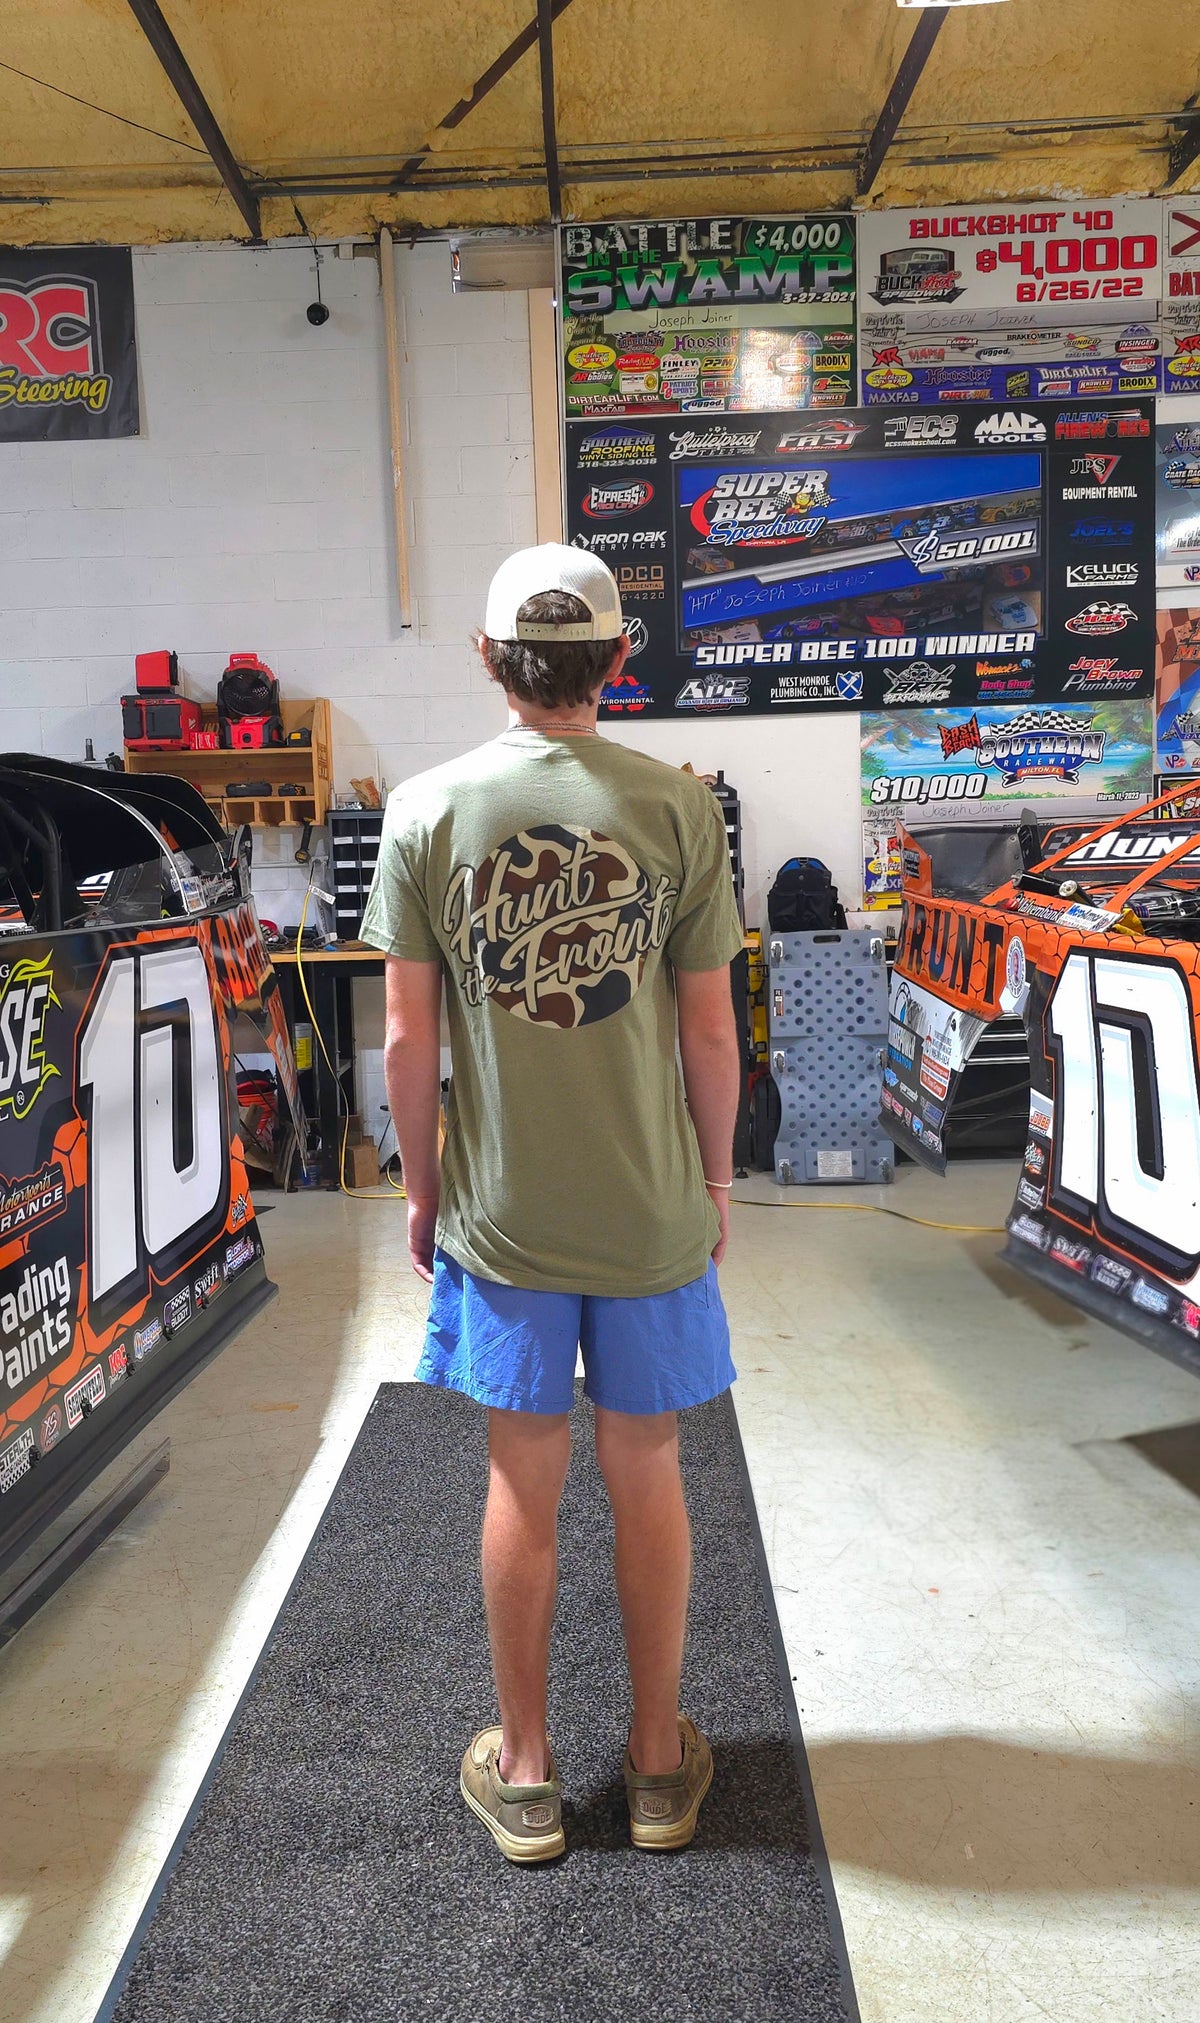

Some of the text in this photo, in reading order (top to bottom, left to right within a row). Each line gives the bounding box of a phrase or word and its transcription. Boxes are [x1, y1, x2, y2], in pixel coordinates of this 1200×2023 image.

[909, 210, 1113, 239] BUCKSHOT 40
[566, 220, 731, 257] BATTLE
[754, 223, 841, 252] $4,000
[586, 250, 661, 266] IN THE
[976, 235, 1158, 280] $4,000
[568, 253, 854, 315] SWAMP
[878, 273, 921, 291] BUCK
[1016, 277, 1143, 303] 6/25/22
[782, 291, 857, 304] 3-27-2021
[879, 288, 951, 299] SPEEDWAY
[649, 307, 733, 328] Joseph Joiner
[917, 310, 977, 329] JOSEPH
[671, 332, 738, 352] Hoosier
[1118, 339, 1157, 347] INSINGER
[704, 359, 734, 367] PPM
[815, 355, 847, 366] BRODIX
[872, 346, 904, 367] XR
[922, 366, 992, 386] Hoosier
[1080, 381, 1110, 389] KNOWLES
[1120, 377, 1153, 387] BRODIX
[0, 368, 107, 409] Steering
[868, 391, 919, 404] MAXFAB
[811, 395, 843, 403] KNOWLES
[904, 415, 959, 438] ECS
[974, 412, 1047, 435] MAC
[1057, 411, 1109, 423] ALLEN'S
[1055, 418, 1150, 440] FIREWORKS
[580, 433, 656, 452] SOUTHERN
[669, 431, 762, 460] Bulletproof
[778, 432, 861, 450] FAST
[884, 439, 956, 447] ecssmokeschool.com
[974, 434, 1047, 444] TOOLS
[591, 444, 655, 454] ROOFING
[577, 458, 657, 468] 318-325-3038
[1070, 457, 1106, 474] JPS
[1165, 470, 1187, 479] CRATE
[712, 471, 828, 498] SUPER
[1062, 486, 1138, 500] EQUIPMENT RENTAL
[591, 485, 640, 509] EXPRESS
[713, 501, 778, 522] BEE
[706, 515, 826, 546] Speedway
[590, 541, 666, 551] SERVICES
[912, 530, 1036, 564] $50,001
[615, 565, 664, 581] DCO
[1067, 562, 1139, 582] KELLICK
[621, 592, 665, 601] 6-4220
[695, 632, 1036, 666] SUPER BEE 100 WINNER
[1068, 656, 1119, 671] Joey
[778, 675, 830, 687] WEST MONROE
[1061, 673, 1137, 692] Plumbing
[1085, 669, 1143, 681] Brown
[770, 686, 838, 699] PLUMBING CO., INC.
[981, 679, 1032, 691] Body Shop
[598, 697, 655, 705] NVIRONMENTAL
[883, 691, 950, 703] PERFORMANCE
[939, 717, 978, 742] BASH
[944, 735, 981, 754] BEACH
[979, 733, 1103, 766] SOUTHERN
[1003, 756, 1077, 767] RACEWAY
[870, 773, 986, 804] $10,000
[1097, 793, 1115, 801] March
[1125, 792, 1140, 800] 2023
[923, 802, 1009, 818] Joseph Joiner
[442, 841, 598, 964] Hunt
[500, 874, 678, 1014] Front
[1051, 953, 1200, 1260] 10
[80, 946, 222, 1301] 10
[1, 1256, 71, 1334] ading
[0, 1308, 71, 1390] aints
[44, 1411, 57, 1437] XS
